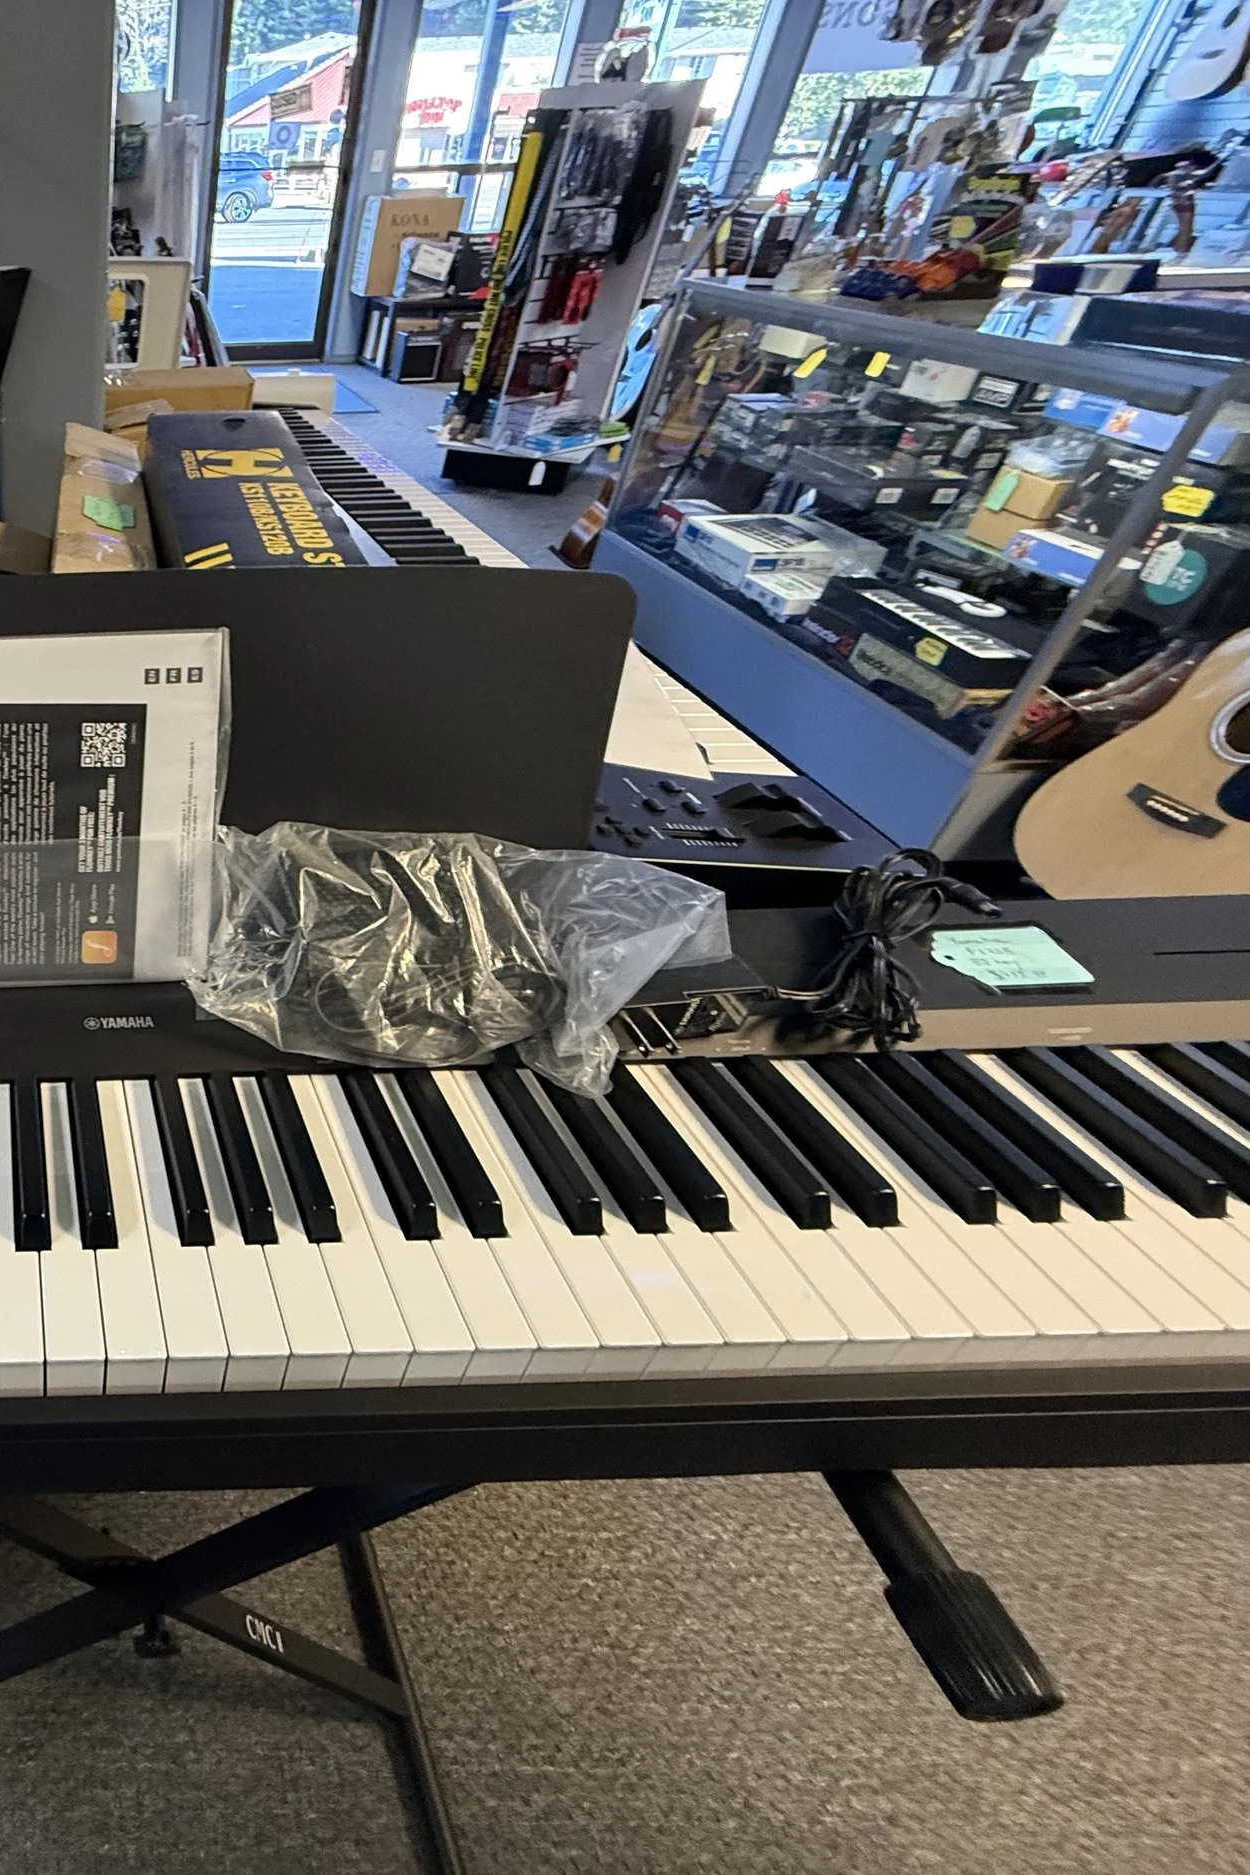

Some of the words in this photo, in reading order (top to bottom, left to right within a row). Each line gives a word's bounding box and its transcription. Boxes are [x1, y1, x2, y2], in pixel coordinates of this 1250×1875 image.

[267, 482, 334, 548] KEYBOARD
[148, 670, 156, 682] EN
[170, 670, 178, 681] FR
[107, 778, 115, 806] PREMIUM
[79, 806, 87, 814] OF
[78, 845, 86, 860] YOUR
[108, 884, 116, 894] Play
[100, 1016, 155, 1029] YAMAHA
